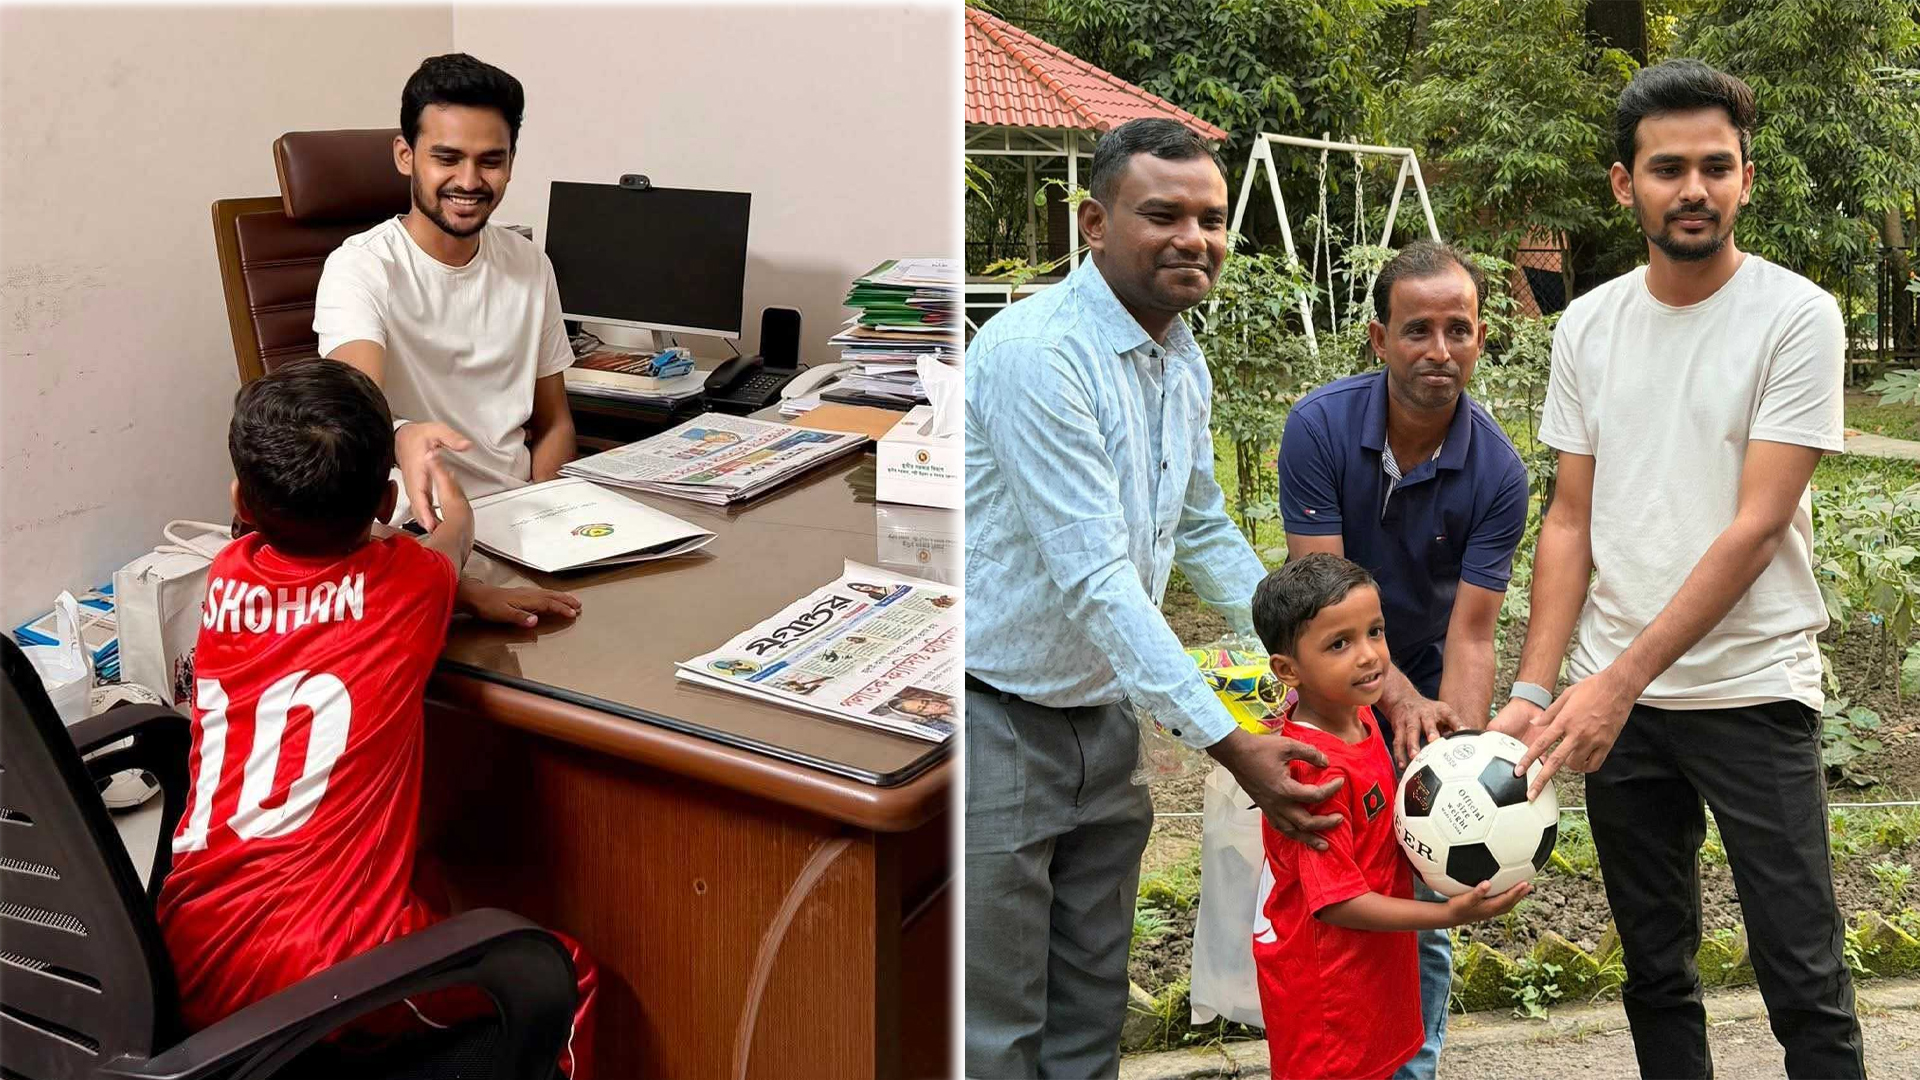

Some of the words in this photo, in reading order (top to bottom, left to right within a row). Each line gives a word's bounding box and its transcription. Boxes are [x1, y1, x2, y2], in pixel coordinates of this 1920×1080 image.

[203, 572, 365, 634] SHOHAN
[745, 595, 853, 656] যুগান্তর
[172, 669, 352, 853] 10
[1447, 802, 1469, 830] weight
[1457, 803, 1471, 819] size
[1458, 788, 1485, 821] Official
